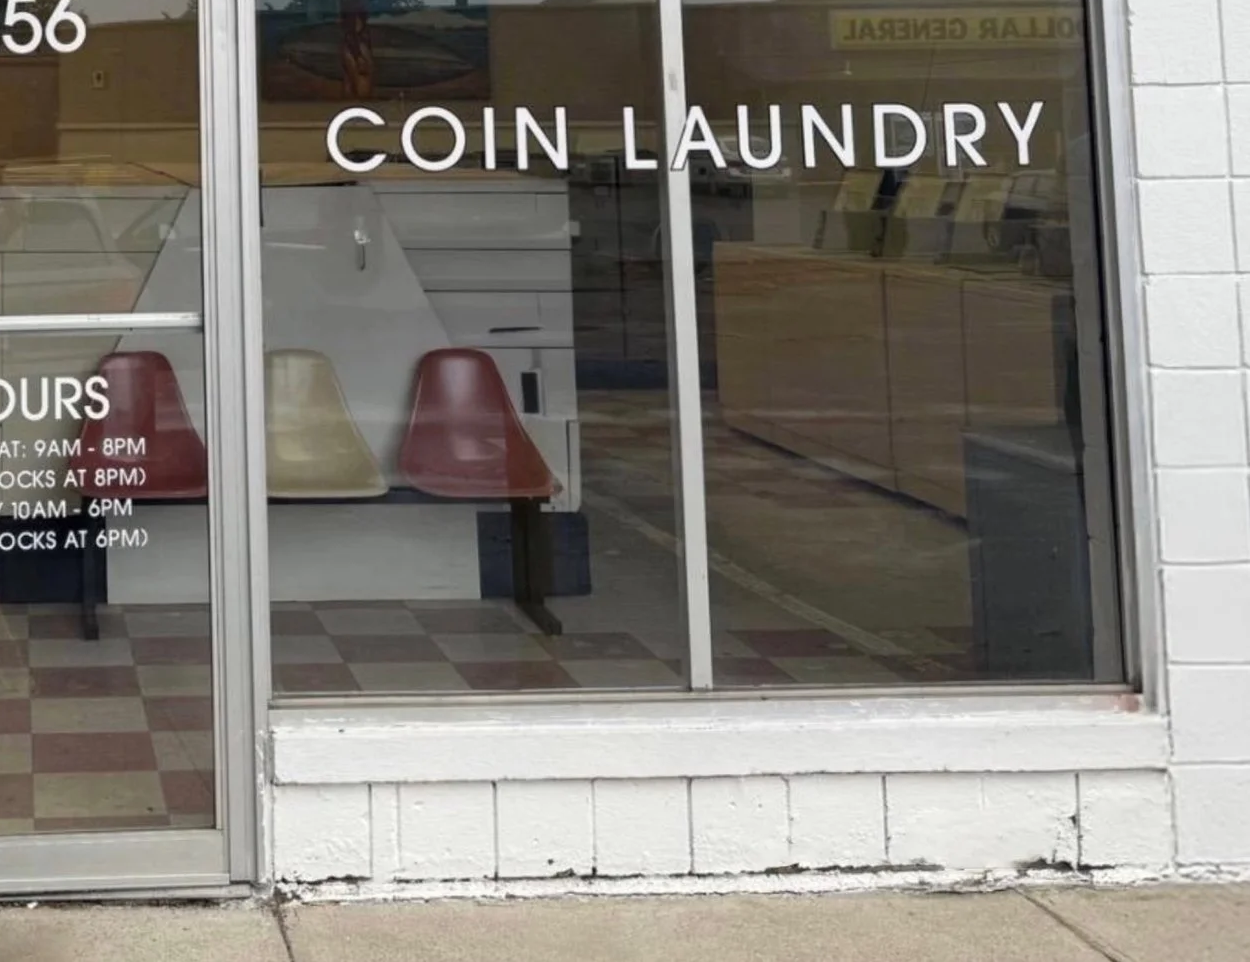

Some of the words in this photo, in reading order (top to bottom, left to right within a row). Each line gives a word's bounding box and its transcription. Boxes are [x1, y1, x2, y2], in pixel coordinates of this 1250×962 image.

[325, 104, 569, 174] COIN
[623, 100, 1045, 171] LAUNDRY
[34, 438, 81, 458] 9AM
[102, 437, 146, 456] 8PM
[63, 469, 87, 488] AT
[94, 467, 147, 487] 8PM)
[11, 500, 67, 519] 10AM
[88, 498, 133, 518] 6PM
[64, 530, 87, 549] AT
[95, 528, 149, 548] 6PM)
